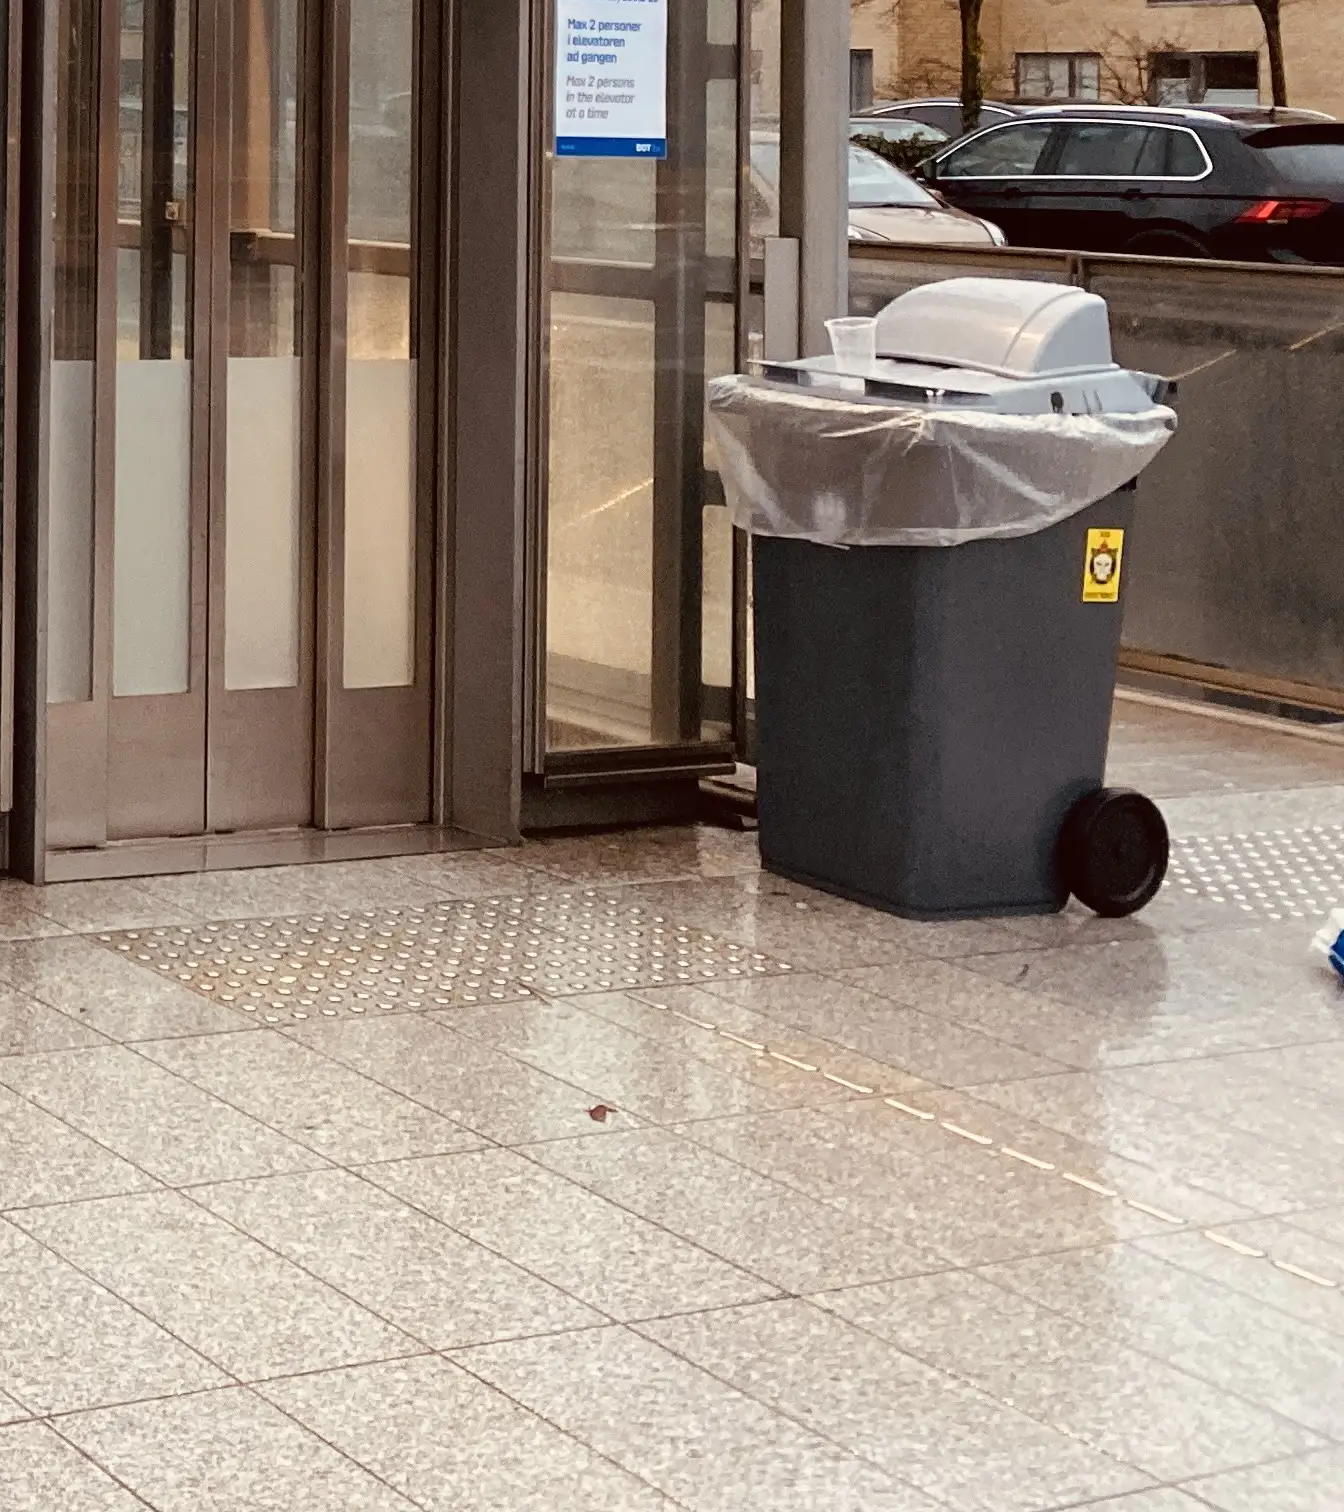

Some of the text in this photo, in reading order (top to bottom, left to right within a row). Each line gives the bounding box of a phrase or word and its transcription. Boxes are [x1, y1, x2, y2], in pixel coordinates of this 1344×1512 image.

[567, 18, 642, 33] Max 2 personer
[572, 35, 625, 47] elevatoren
[566, 51, 617, 65] ad gangen
[566, 75, 635, 89] Max 2 persons
[566, 90, 636, 104] in the elevator
[566, 107, 609, 119] at a time
